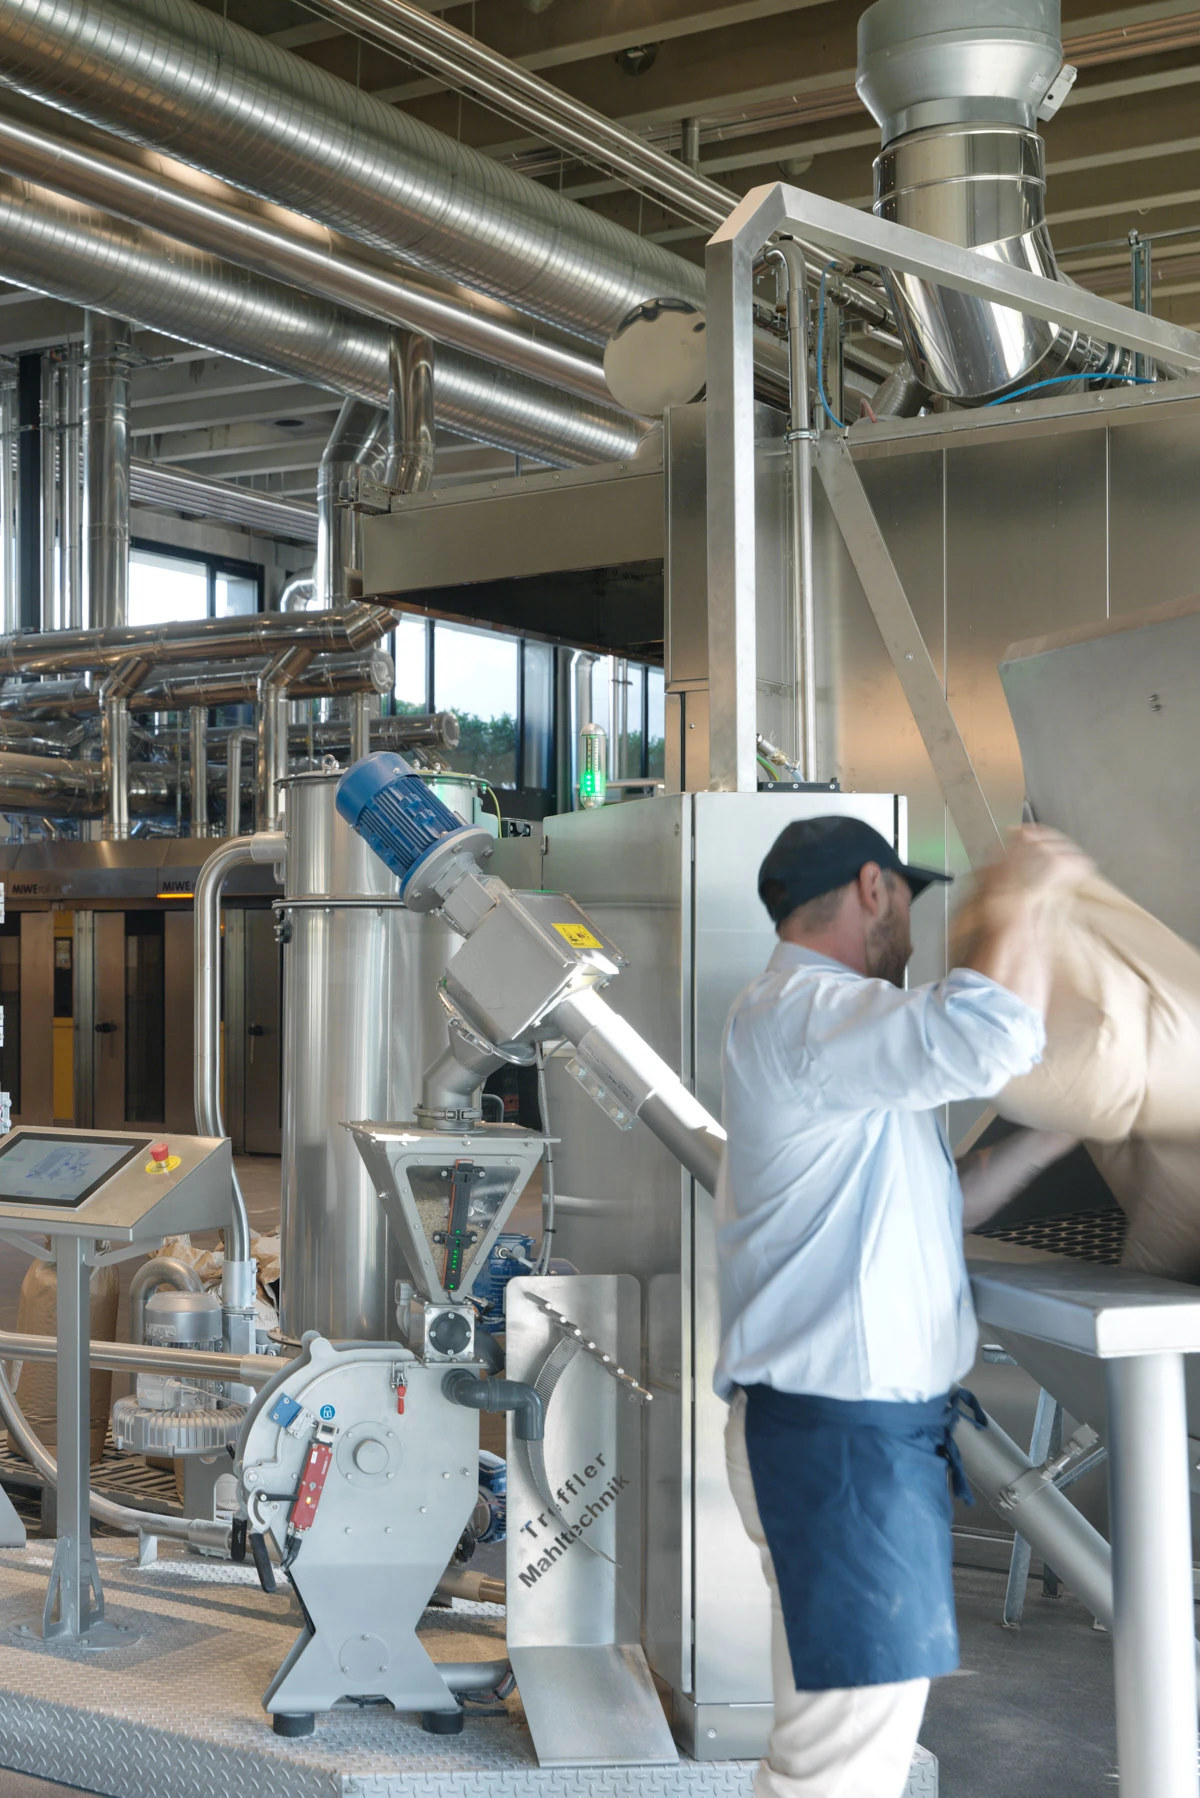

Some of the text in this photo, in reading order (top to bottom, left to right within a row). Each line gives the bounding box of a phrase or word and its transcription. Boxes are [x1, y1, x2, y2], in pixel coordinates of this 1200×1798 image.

[12, 884, 39, 894] MIWE
[162, 881, 191, 891] MIWE
[518, 1475, 631, 1589] Mahltechnik
